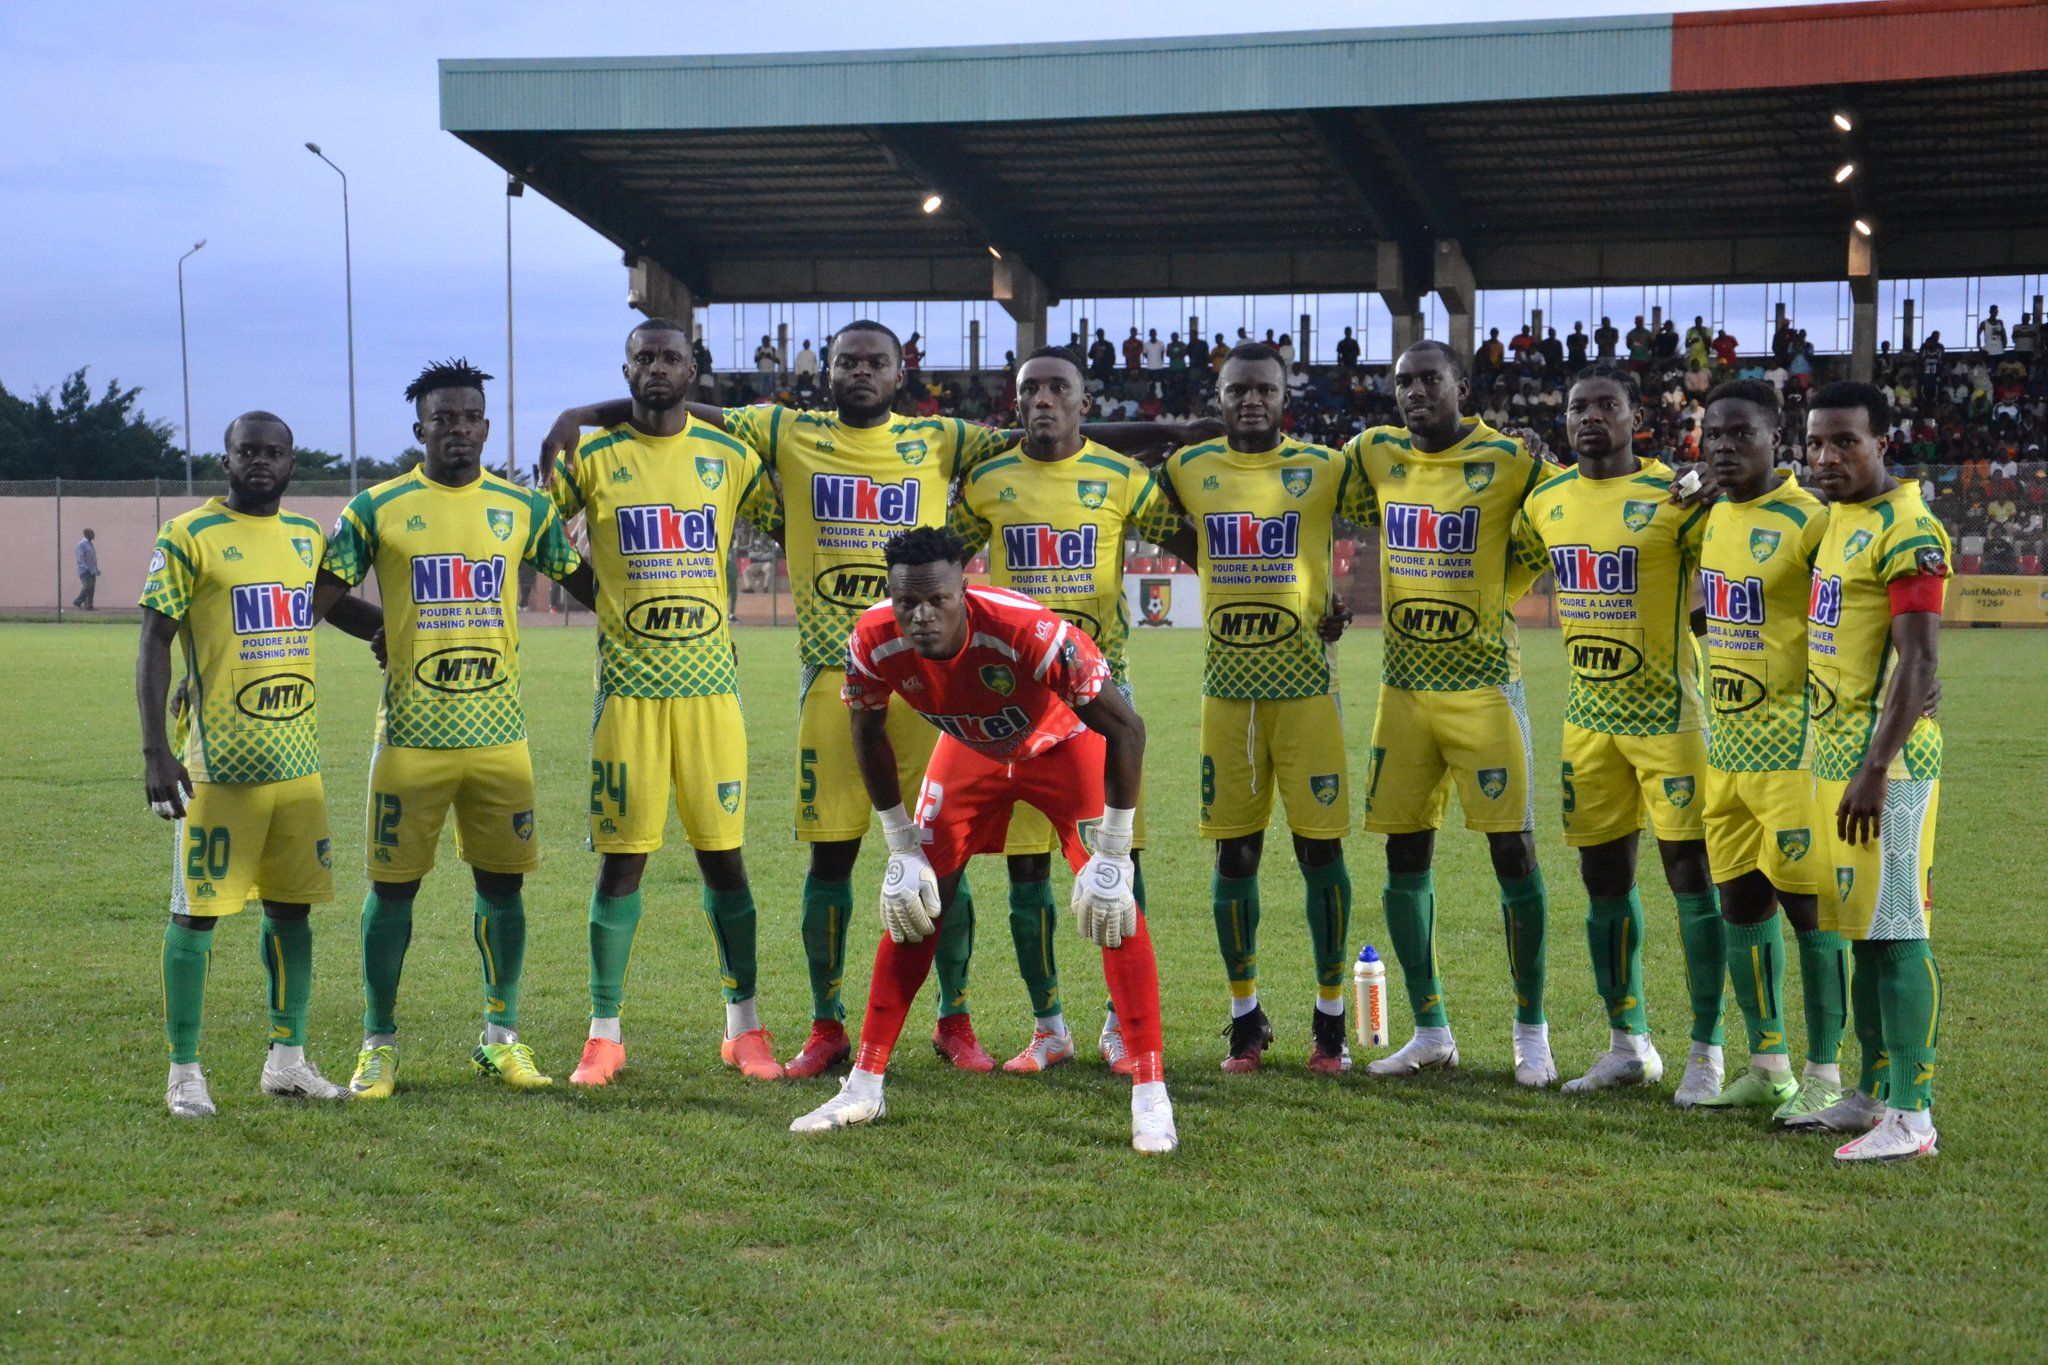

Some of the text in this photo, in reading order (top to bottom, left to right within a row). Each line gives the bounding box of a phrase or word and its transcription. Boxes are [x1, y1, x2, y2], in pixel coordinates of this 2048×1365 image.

[815, 476, 918, 525] Nikel
[617, 505, 717, 553] Nikel
[820, 526, 865, 537] POUDRE
[868, 529, 876, 537] A
[1206, 513, 1299, 557] Nikel
[1387, 505, 1479, 552] Nikel
[817, 538, 868, 549] WASHING
[1004, 525, 1096, 568] Nikel
[628, 558, 673, 568] POUDRE
[676, 558, 684, 566] A
[1389, 554, 1472, 567] POUDRE A LAVER
[626, 569, 678, 580] WASHING
[1213, 563, 1294, 573] POUDRE A LAVER
[1388, 567, 1475, 579] WASHING POWDER
[1550, 546, 1638, 592] Nikel
[413, 556, 506, 600] Nikel
[1011, 573, 1093, 584] POUDRE A LAVER
[1211, 574, 1298, 584] WASHING POWDER
[1055, 585, 1095, 595] POWDER
[1559, 598, 1633, 608] POUDRE A LAVER
[419, 607, 462, 618] POUDRE
[465, 607, 472, 616] A
[644, 606, 706, 631] MTN
[1593, 610, 1637, 620] POWDER
[416, 618, 466, 630] WASHING
[1220, 612, 1280, 636] MTN
[1402, 607, 1460, 633] MTN
[1729, 628, 1760, 639] LAVER
[242, 635, 309, 648] POUDRE A LAV
[1724, 639, 1765, 651] POWDER
[239, 647, 310, 660] WASHING POWD
[1573, 644, 1622, 671] MTN
[435, 657, 497, 682] MTN
[256, 684, 305, 711] MTN
[801, 748, 819, 803] 5
[591, 760, 628, 817] 24
[374, 792, 402, 847] 12
[187, 825, 231, 881] 20
